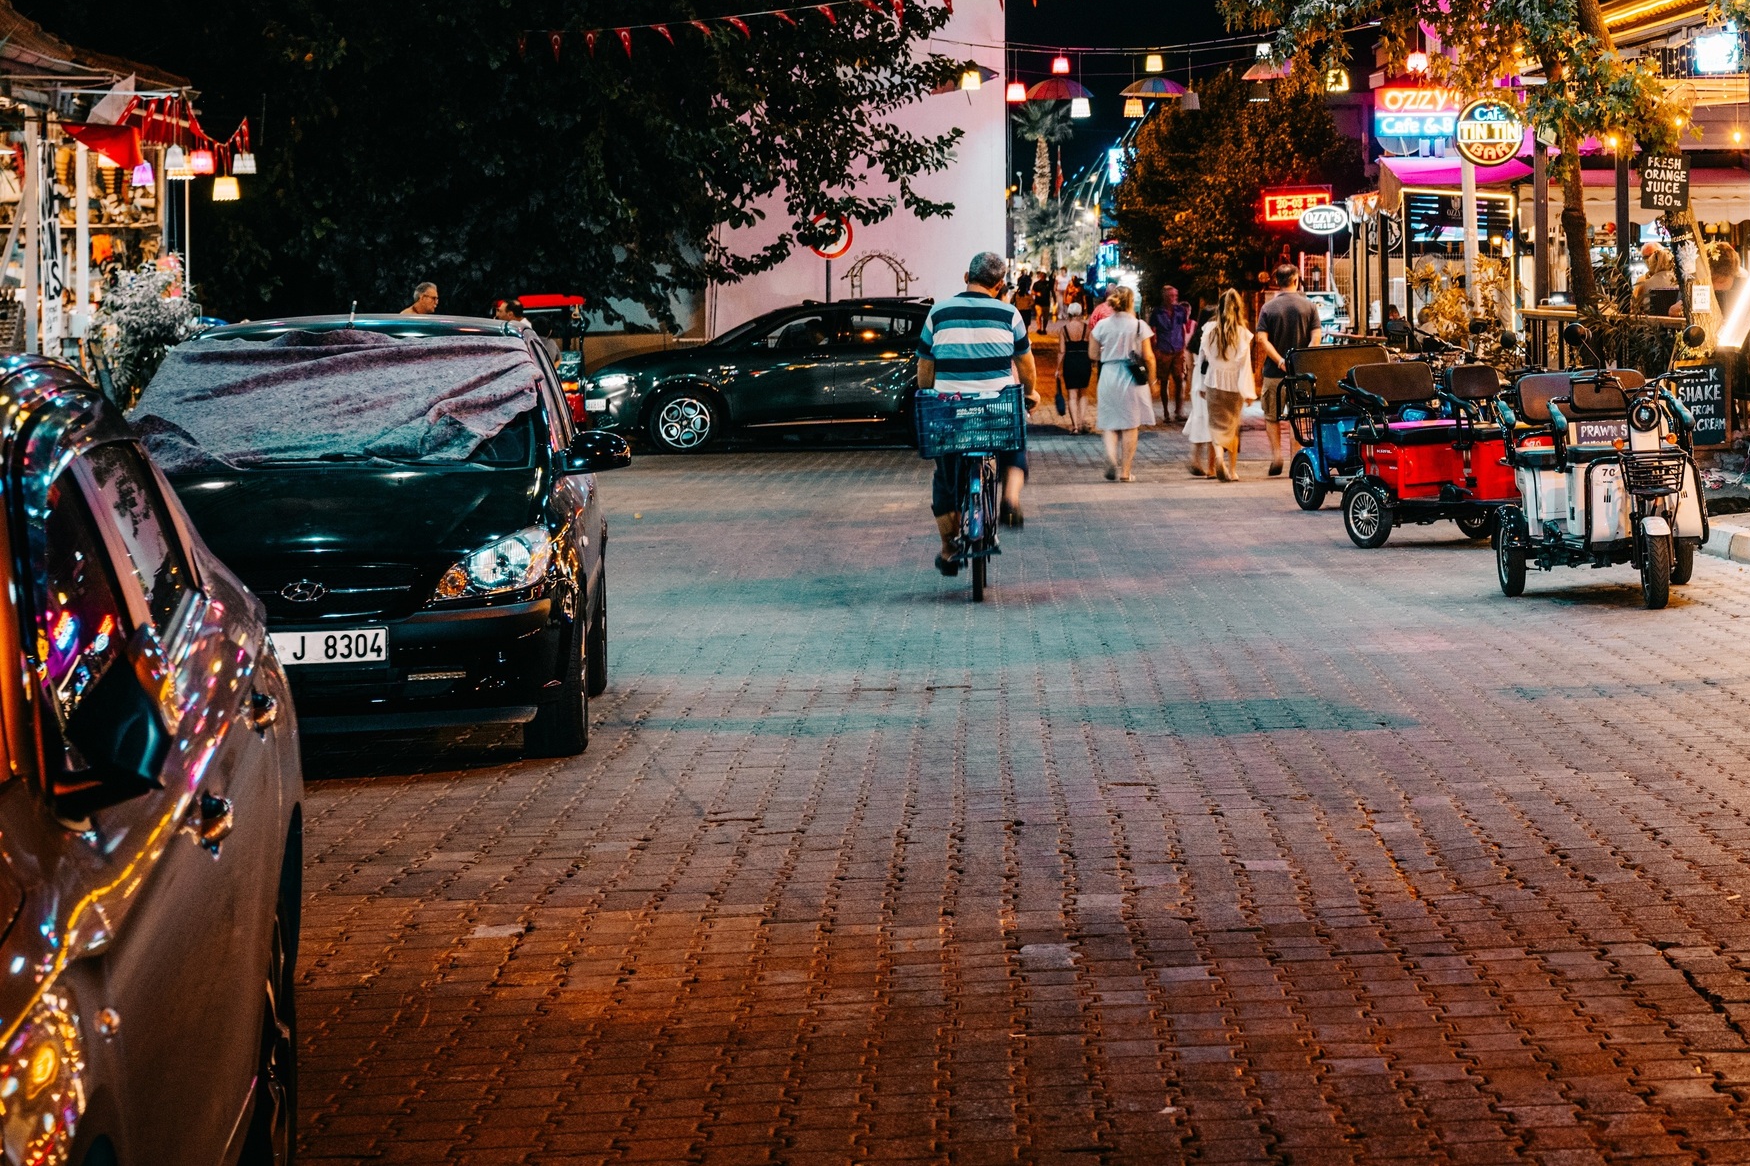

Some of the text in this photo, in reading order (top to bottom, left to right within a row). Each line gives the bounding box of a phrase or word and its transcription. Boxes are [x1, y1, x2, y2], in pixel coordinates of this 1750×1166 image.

[1382, 116, 1420, 134] Cafe
[1460, 122, 1519, 140] TIN TIN
[1469, 142, 1511, 160] BAR
[1647, 156, 1682, 170] FRESH
[1644, 169, 1687, 182] ORANGE
[1645, 181, 1681, 194] JUICE
[1653, 194, 1673, 207] 130
[1678, 384, 1722, 403] SHAKE
[1690, 404, 1714, 416] FROM
[1580, 425, 1618, 438] PRAWN
[1602, 468, 1616, 477] 70
[293, 633, 383, 660] J 8304
